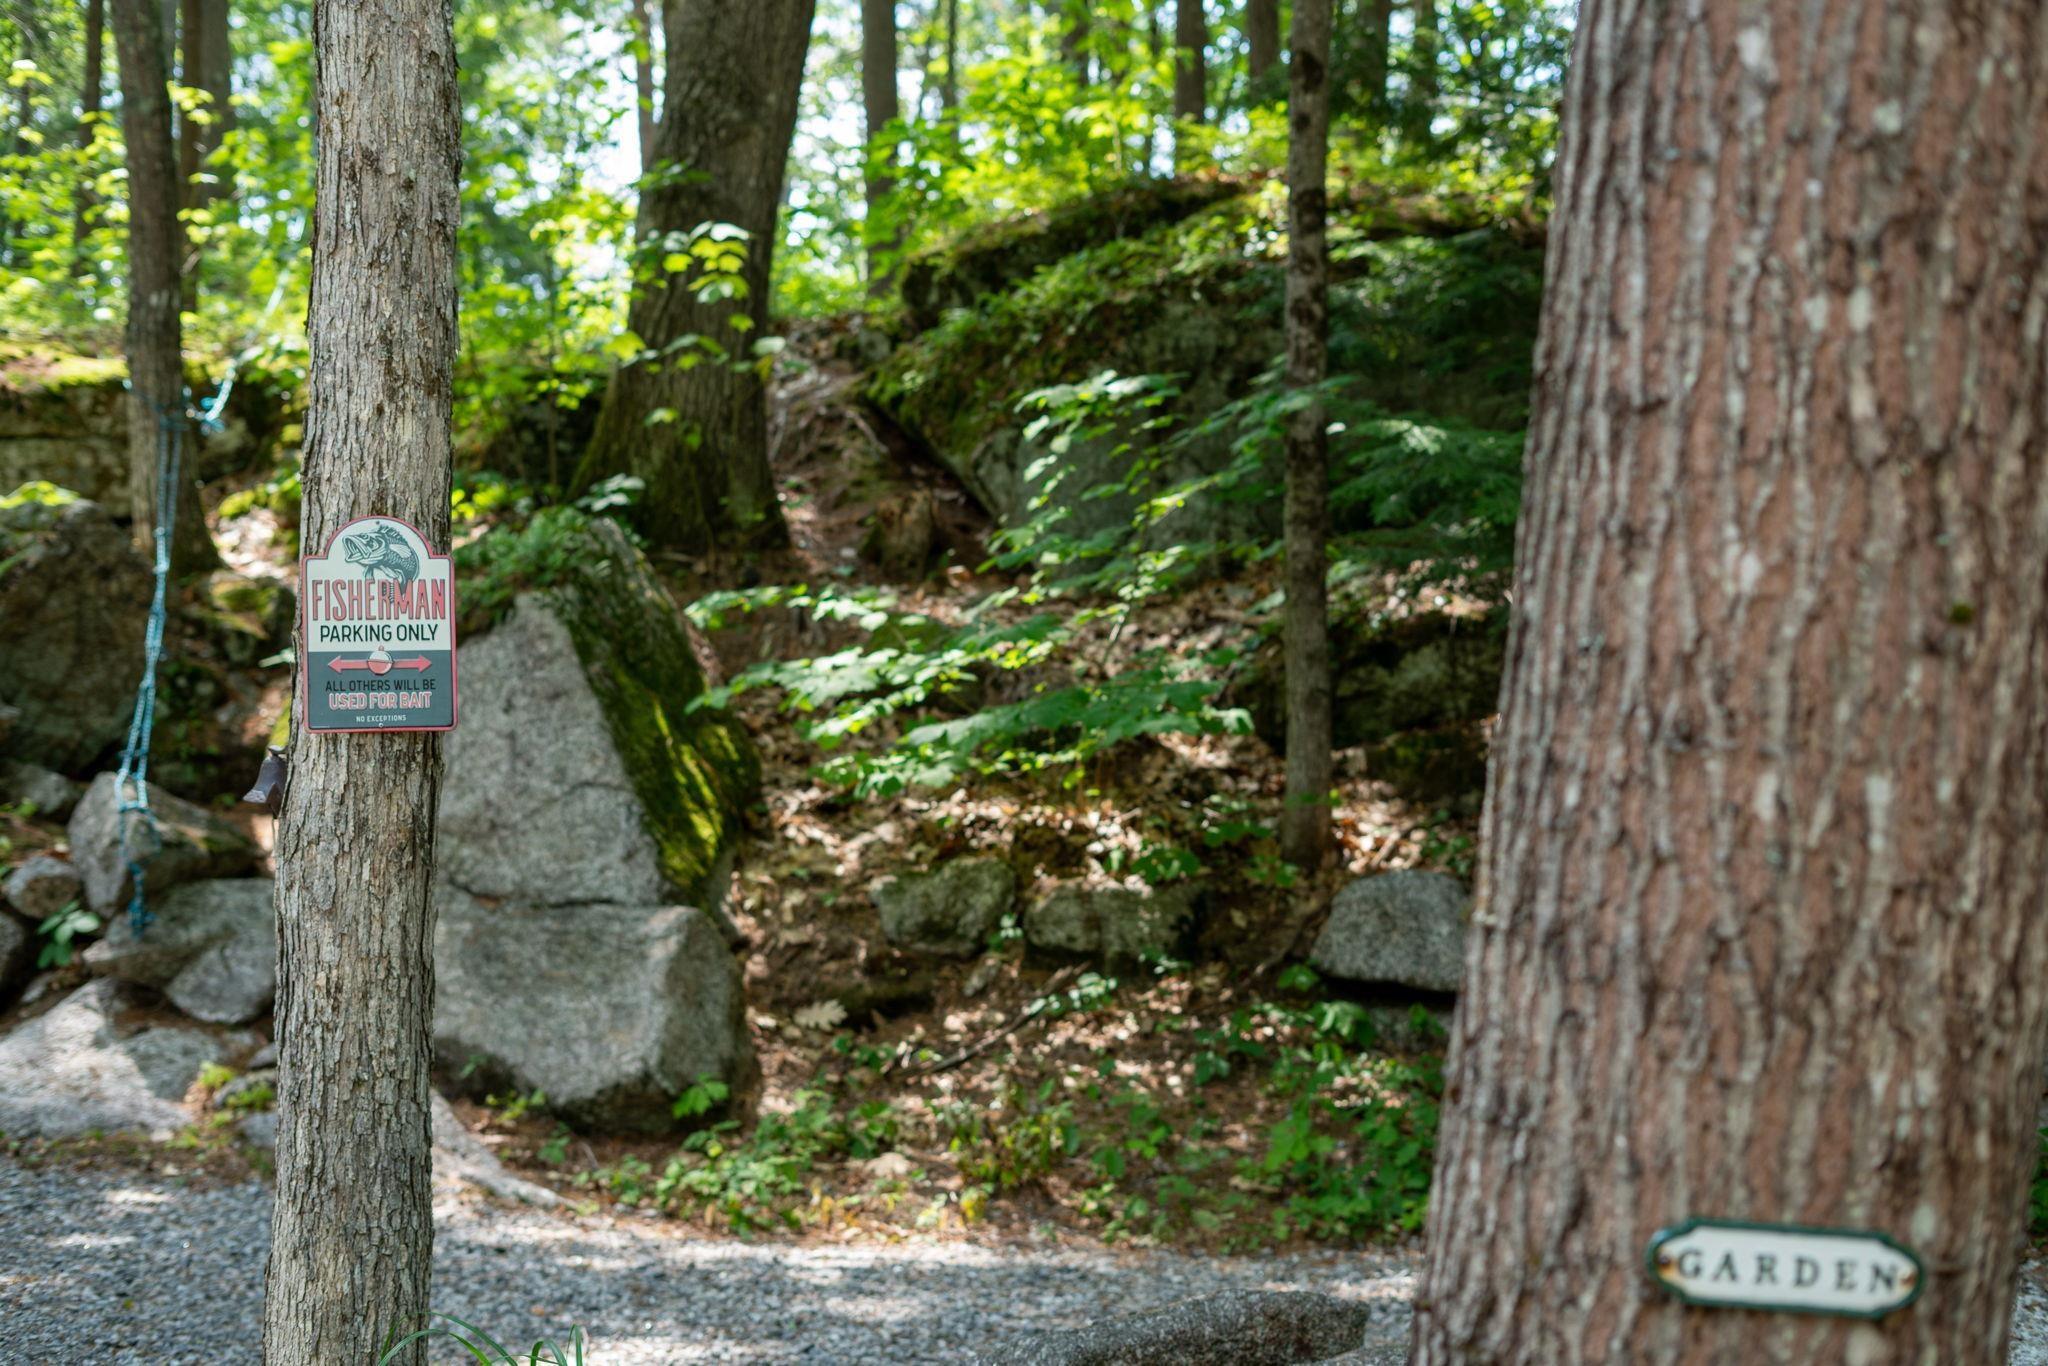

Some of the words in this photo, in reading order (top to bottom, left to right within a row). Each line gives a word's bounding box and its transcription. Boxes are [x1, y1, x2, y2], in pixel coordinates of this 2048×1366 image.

[311, 578, 446, 621] FISHERMAN
[320, 624, 392, 642] PARKING
[396, 623, 438, 641] ONLY
[325, 680, 346, 692] ALL
[348, 679, 391, 691] OTHERS
[393, 679, 419, 690] WILL
[422, 678, 436, 690] BE
[328, 692, 367, 710] USED
[369, 692, 398, 709] FOR
[399, 691, 432, 709] BAIT
[366, 714, 407, 722] EXCEPTIONS
[1676, 1247, 1899, 1294] GARDEN
